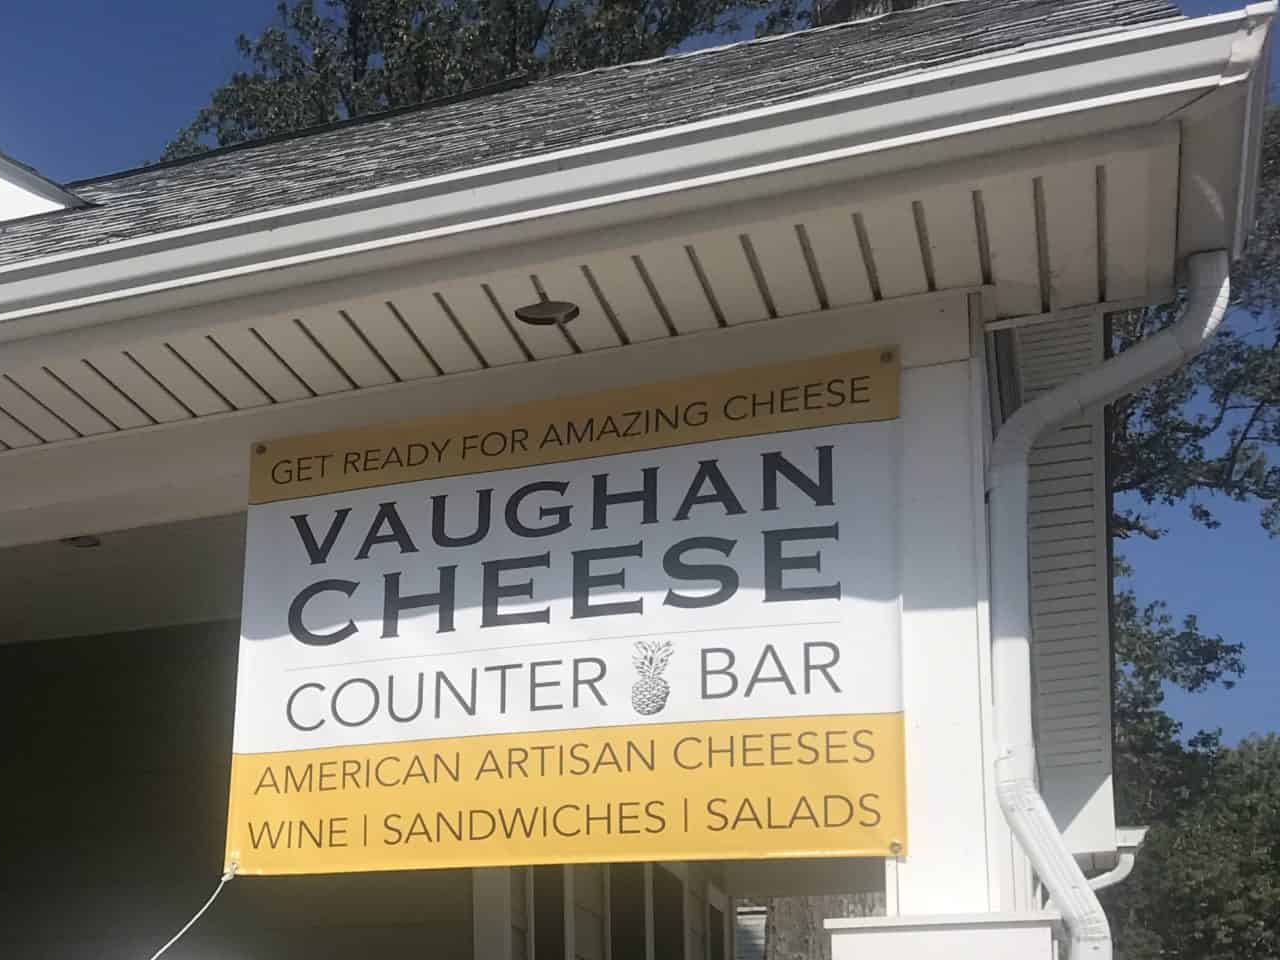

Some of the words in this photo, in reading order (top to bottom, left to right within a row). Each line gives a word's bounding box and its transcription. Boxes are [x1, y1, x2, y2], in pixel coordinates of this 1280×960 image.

[270, 454, 335, 485] GET
[343, 438, 452, 476] READY
[460, 428, 529, 461] FOR
[539, 401, 709, 451] AMAZING
[723, 375, 872, 422] CHEESE
[289, 444, 836, 565] VAUGHAN
[287, 521, 842, 647] CHEESE
[285, 656, 609, 732] COUNTER
[699, 640, 844, 700] BAR
[253, 752, 461, 796] AMERICAN
[473, 739, 657, 782] ARTISAN
[673, 728, 876, 770] CHEESES
[246, 816, 349, 850] WINE
[382, 800, 667, 846] SANDWICHES
[705, 792, 883, 832] SALADS
